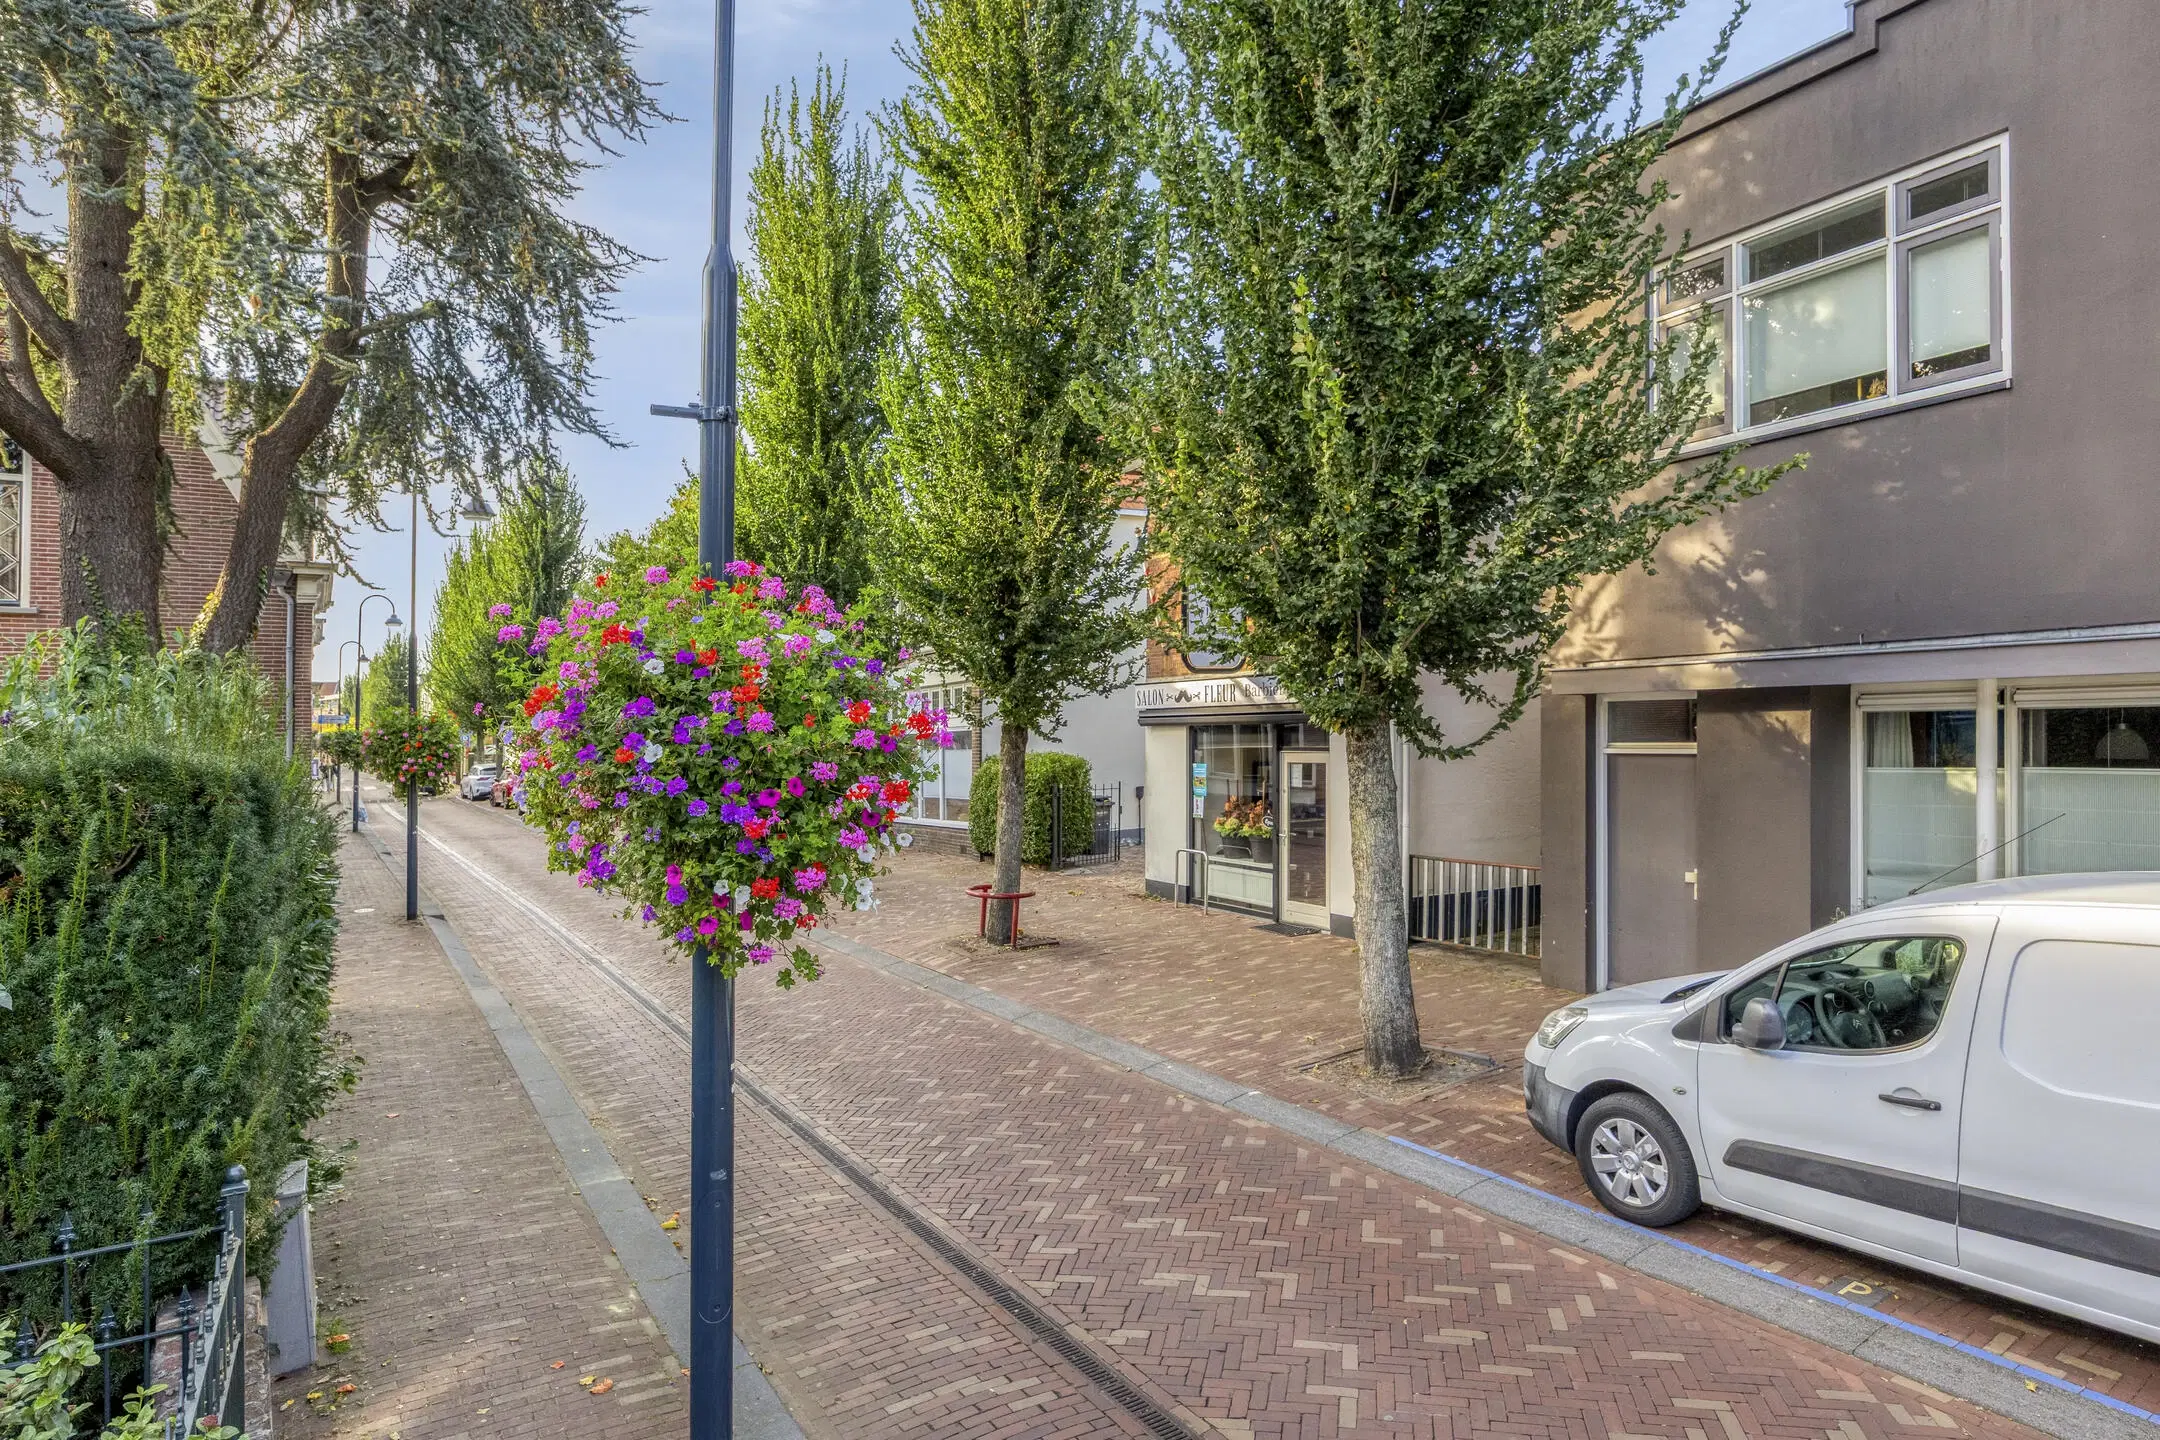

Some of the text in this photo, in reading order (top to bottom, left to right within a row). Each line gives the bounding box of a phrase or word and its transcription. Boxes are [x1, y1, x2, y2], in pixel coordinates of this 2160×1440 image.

[1136, 689, 1164, 706] SALON
[1204, 683, 1236, 703] FLEUR
[1837, 1280, 1873, 1295] P
